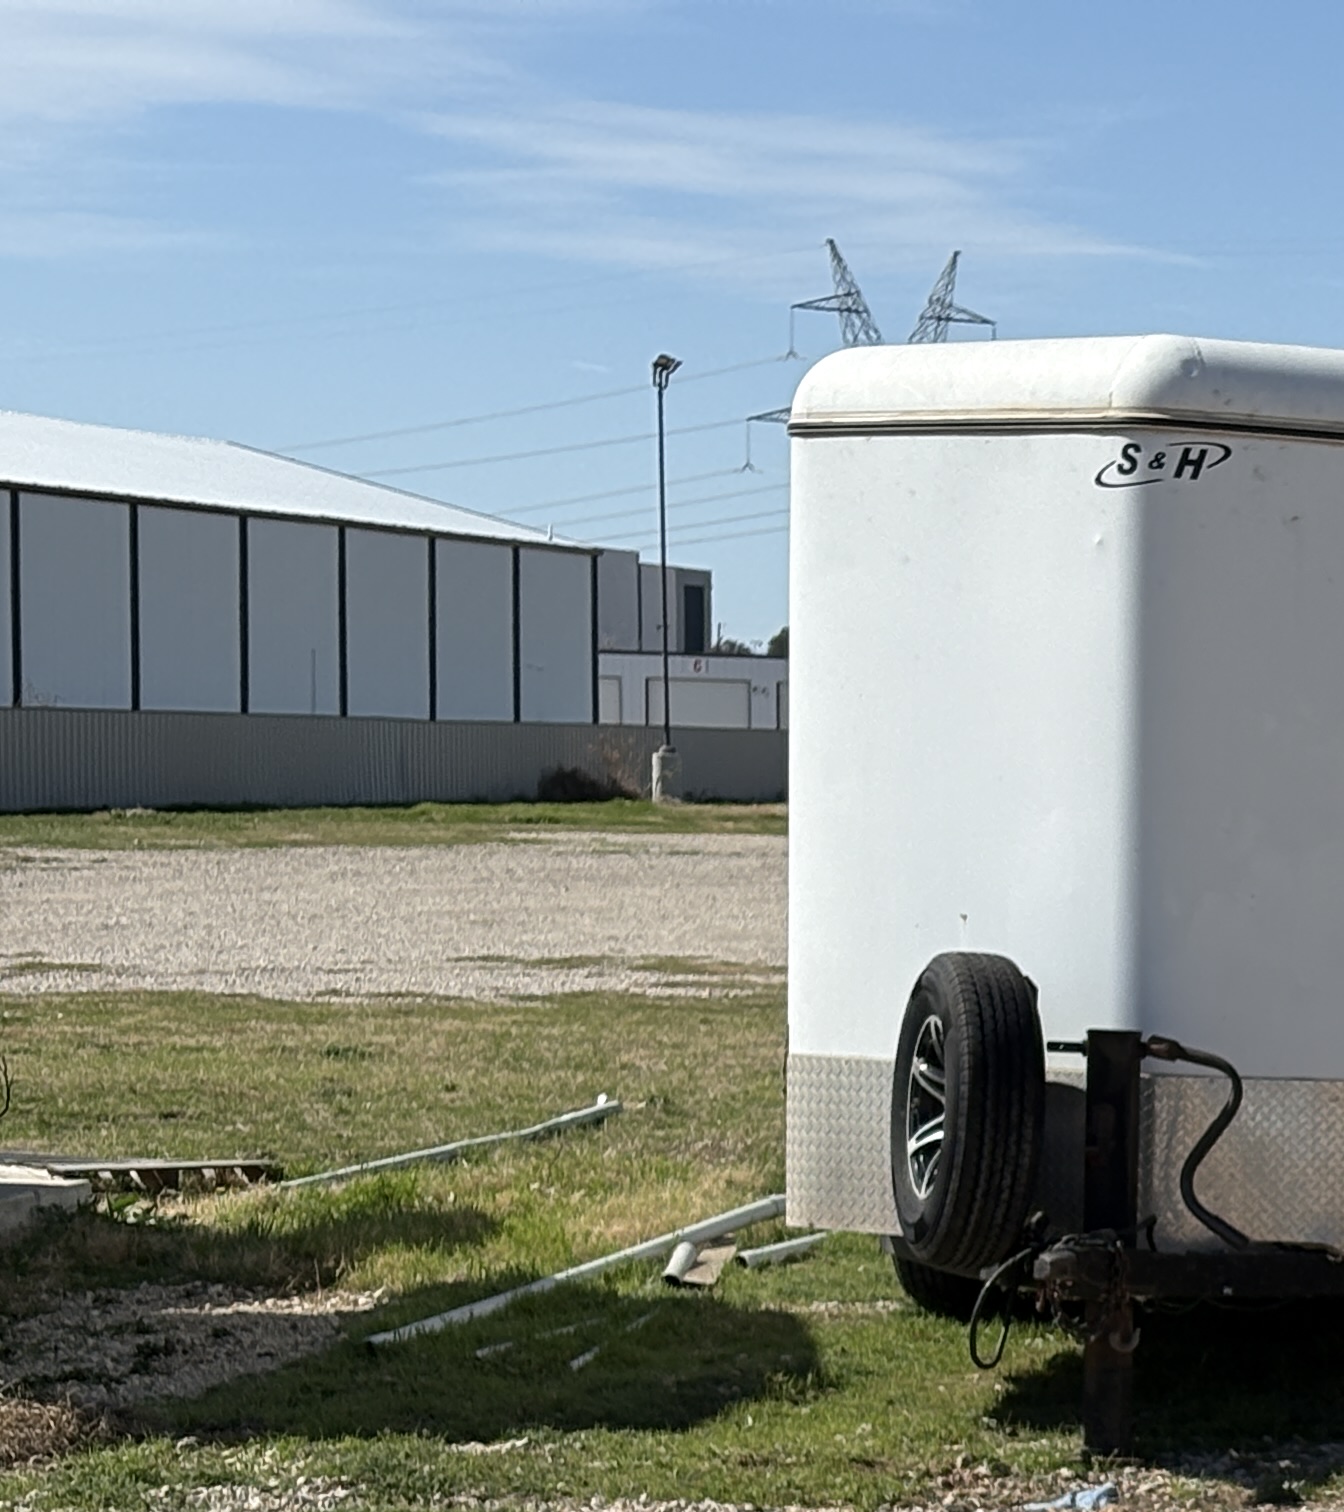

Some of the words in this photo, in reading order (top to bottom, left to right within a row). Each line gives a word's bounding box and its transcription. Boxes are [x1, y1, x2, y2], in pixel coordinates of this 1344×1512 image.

[1117, 443, 1142, 475] S
[1148, 452, 1166, 470] &
[1173, 447, 1208, 480] H
